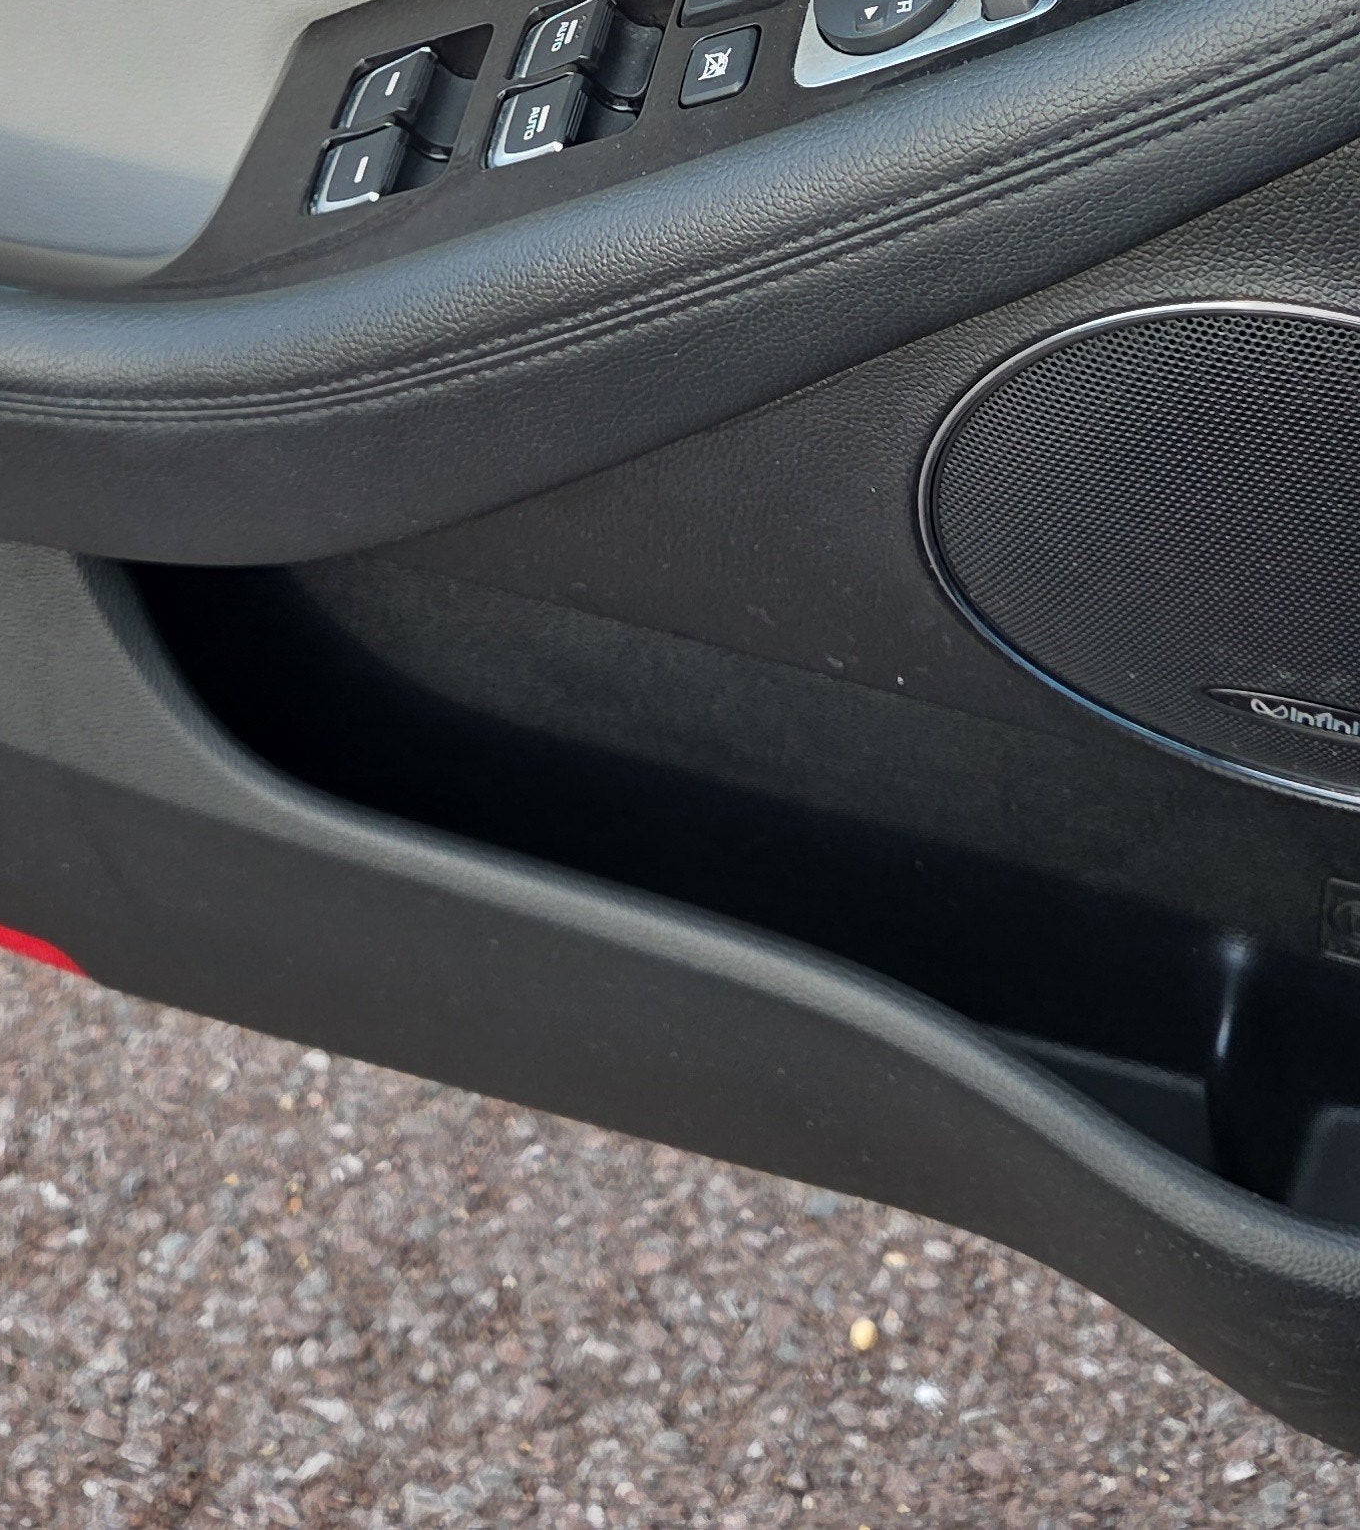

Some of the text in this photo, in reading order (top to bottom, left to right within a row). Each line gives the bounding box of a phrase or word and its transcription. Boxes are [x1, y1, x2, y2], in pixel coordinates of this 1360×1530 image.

[896, 0, 913, 14] R
[551, 21, 570, 52] AUTO
[523, 106, 541, 141] AUTO
